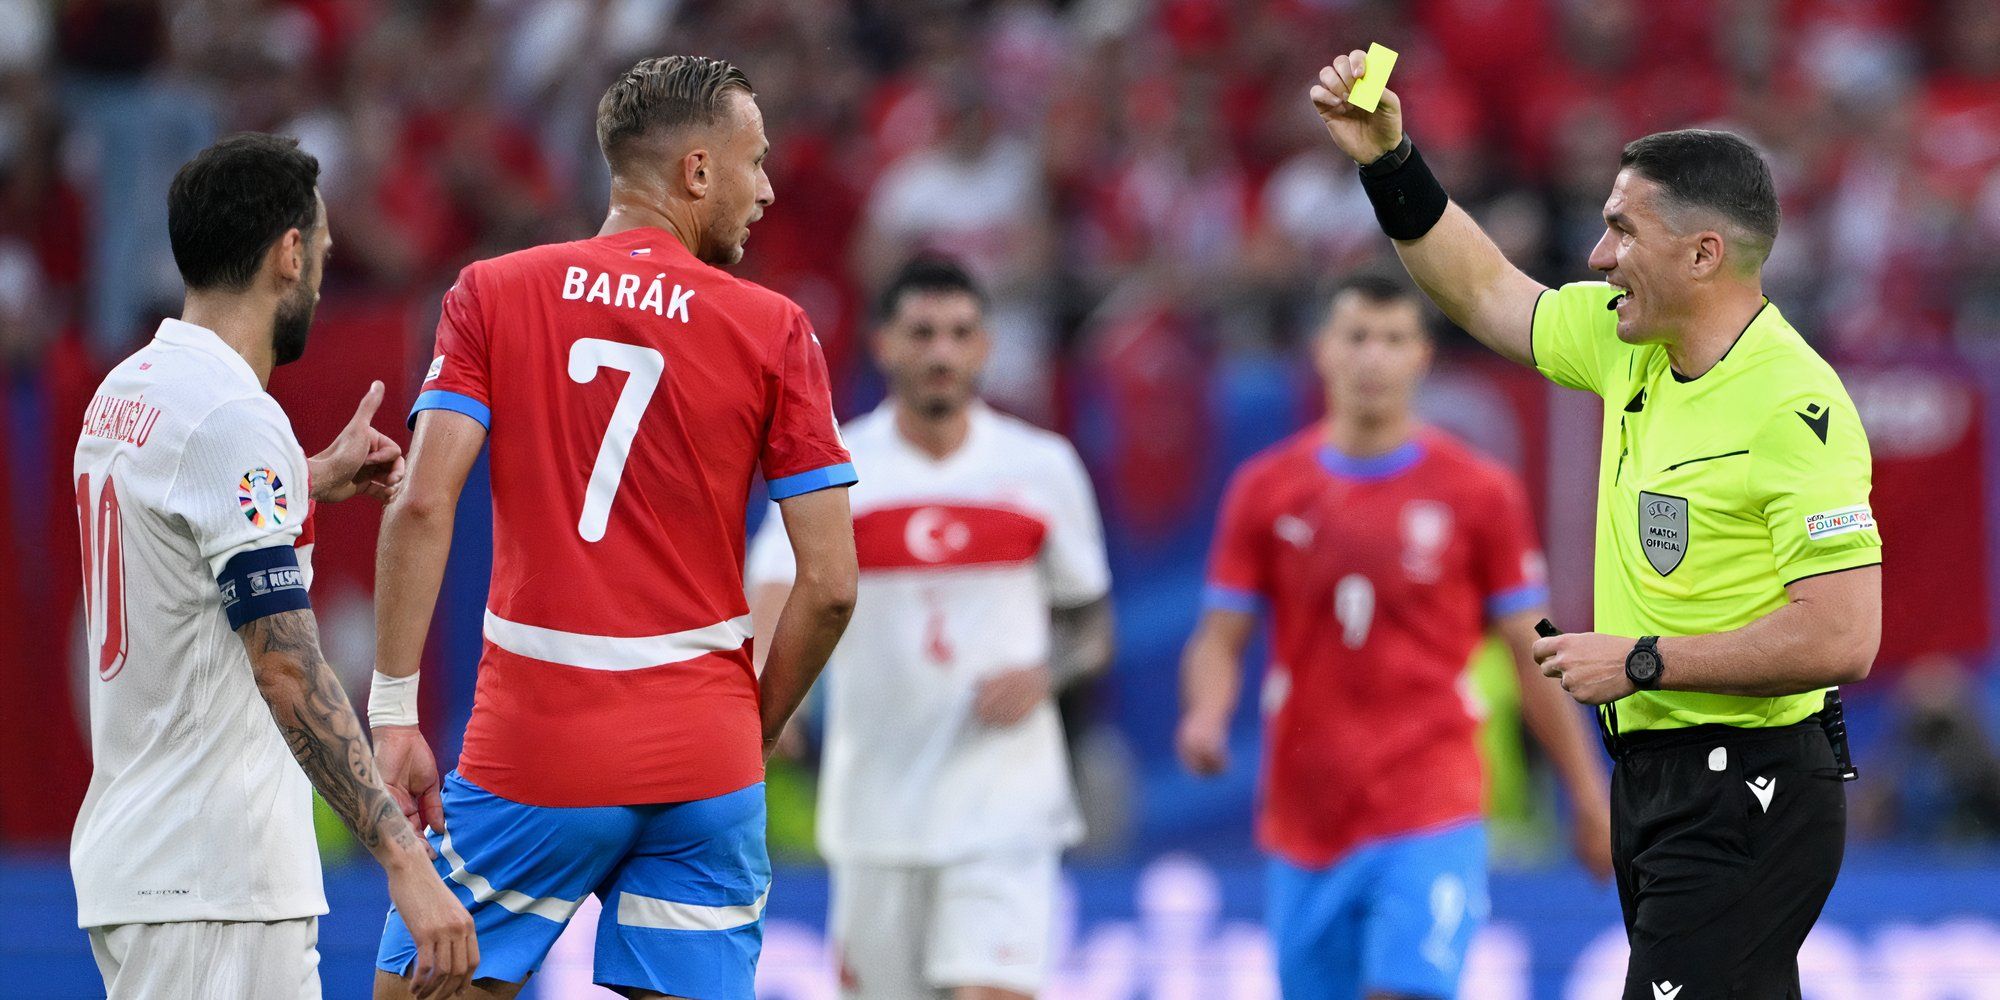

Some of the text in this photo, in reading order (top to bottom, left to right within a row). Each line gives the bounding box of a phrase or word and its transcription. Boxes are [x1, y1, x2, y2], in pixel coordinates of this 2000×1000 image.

[562, 266, 695, 323] BARÁK
[568, 338, 664, 542] 7
[1646, 538, 1680, 552] OFFICIAL
[1649, 526, 1678, 539] MATCH
[76, 473, 128, 682] 10
[1334, 573, 1376, 650] 9
